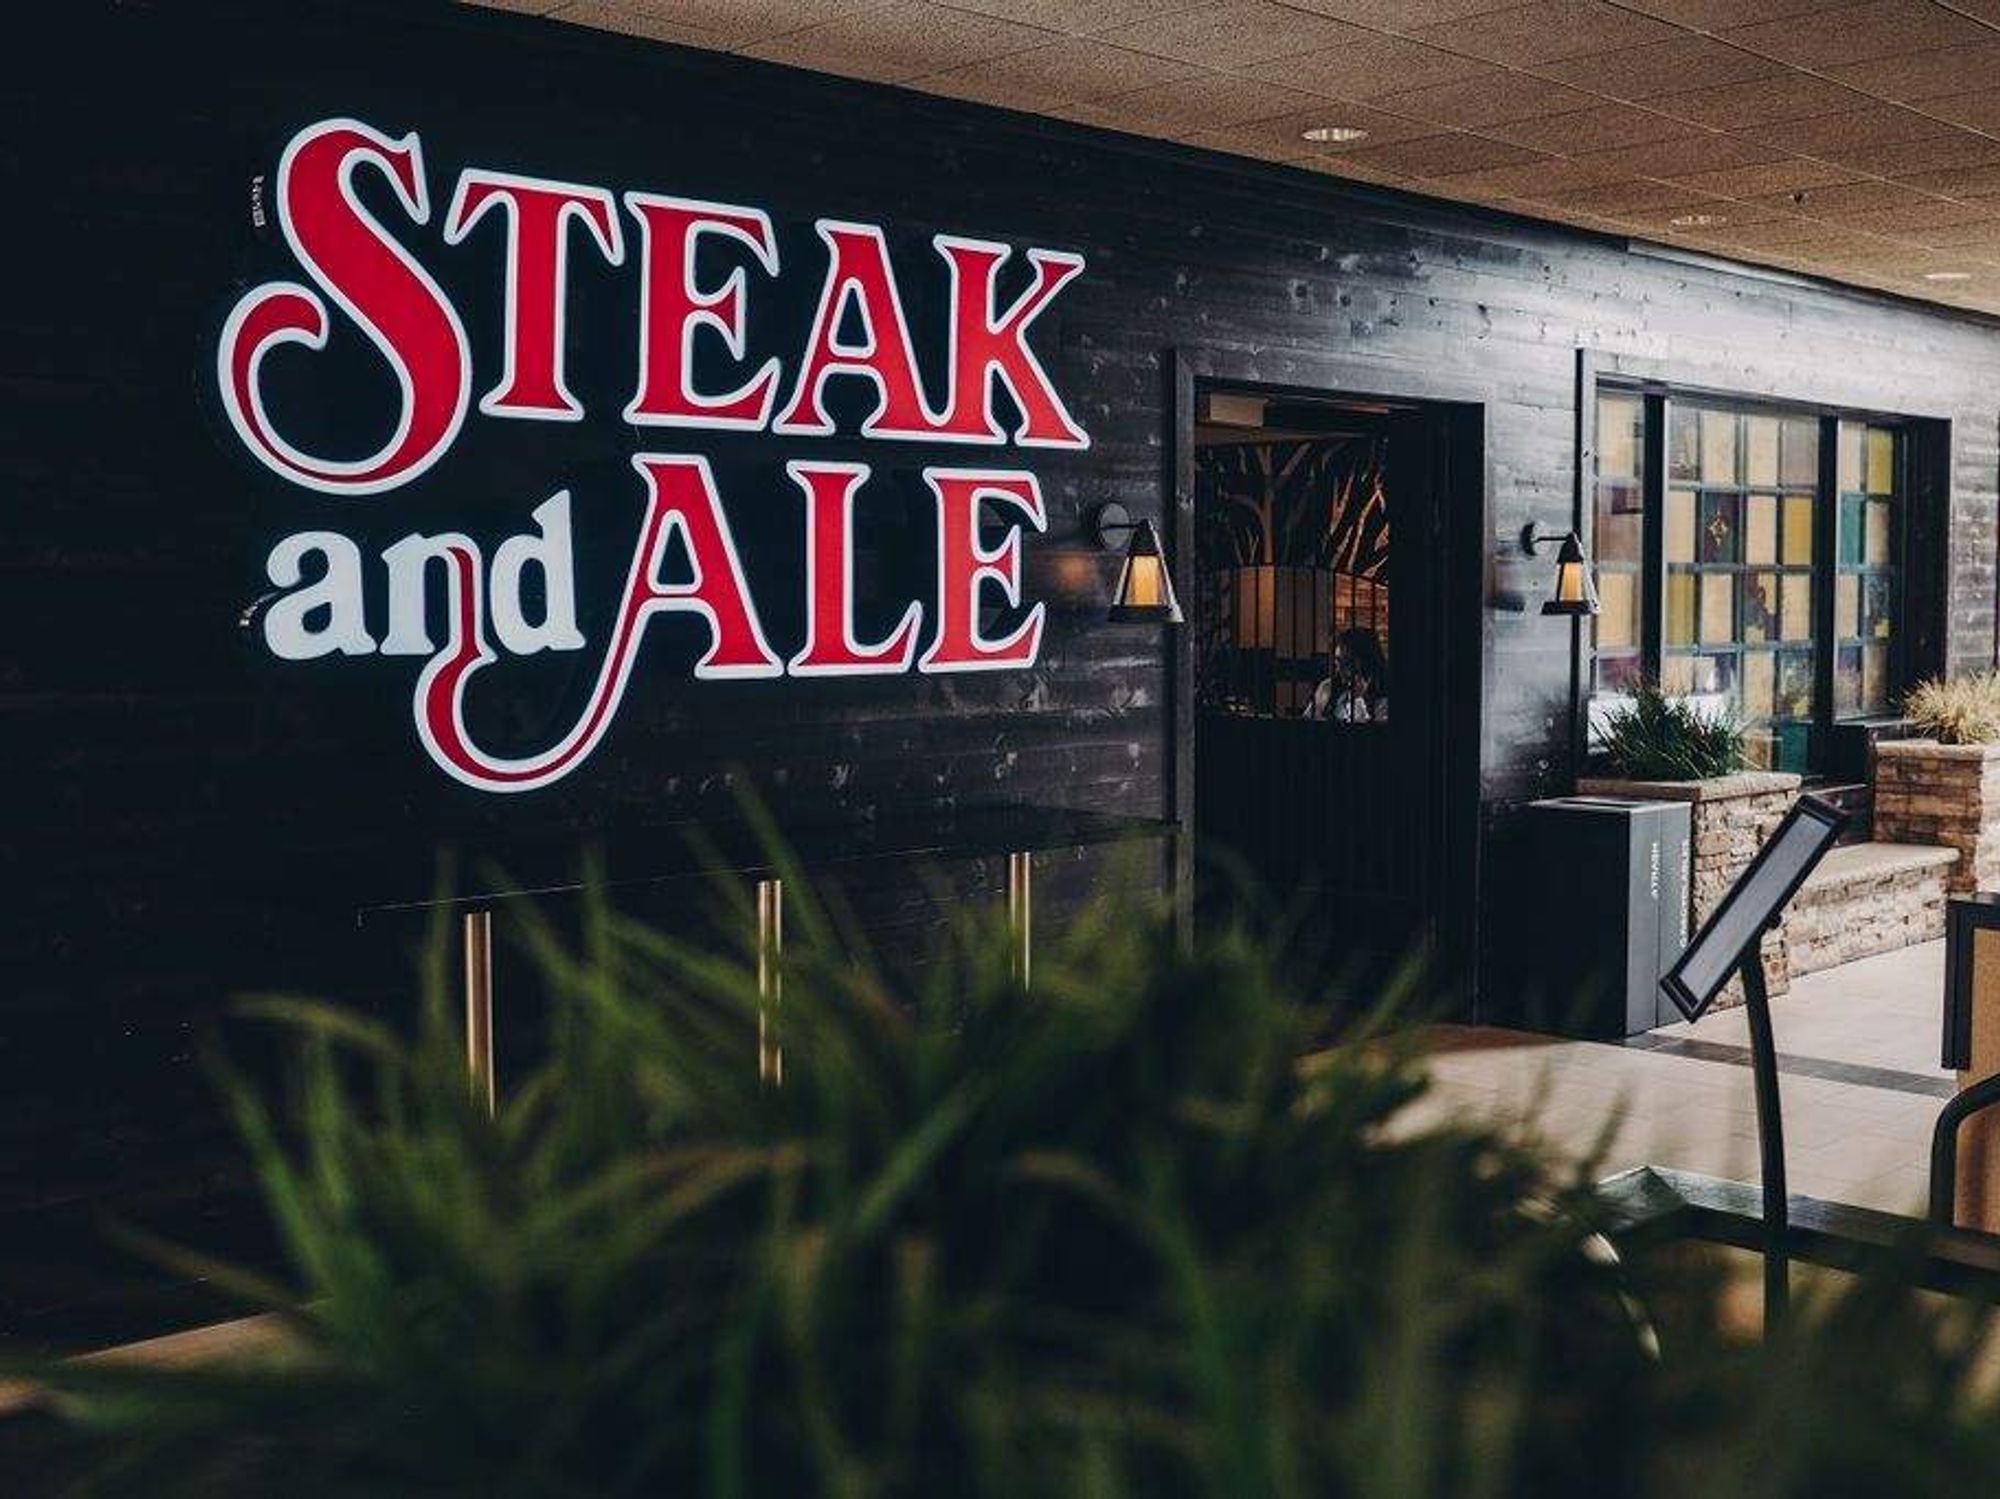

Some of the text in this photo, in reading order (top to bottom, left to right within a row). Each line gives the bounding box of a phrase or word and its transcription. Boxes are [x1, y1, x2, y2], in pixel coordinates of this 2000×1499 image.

[218, 118, 1091, 495] STEAK
[264, 452, 1048, 793] and ALE
